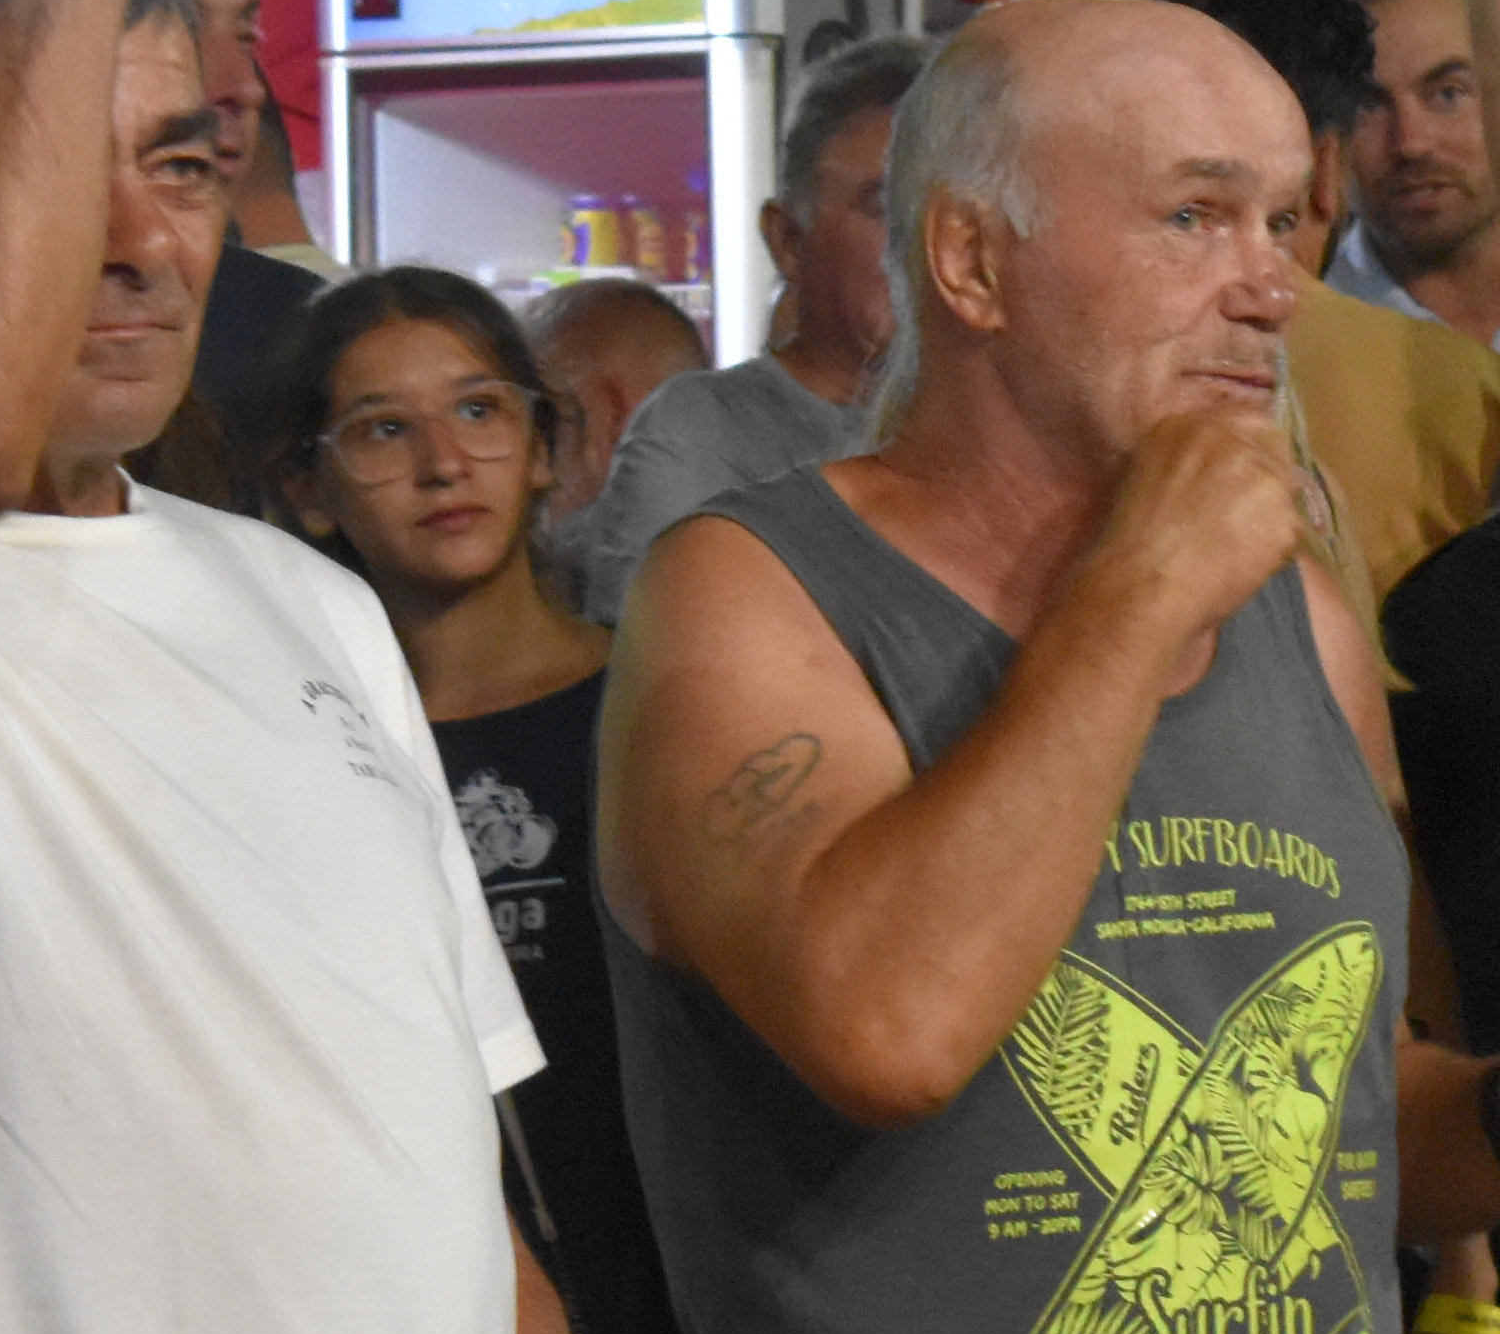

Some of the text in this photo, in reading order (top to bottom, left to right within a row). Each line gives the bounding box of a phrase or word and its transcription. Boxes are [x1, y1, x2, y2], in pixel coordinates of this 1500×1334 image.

[1127, 815, 1342, 899] SURFBOARDS
[1108, 1043, 1159, 1148] Riders
[993, 1167, 1068, 1191] OPENING
[1023, 1194, 1046, 1213] TO
[1048, 1191, 1081, 1211] SAT
